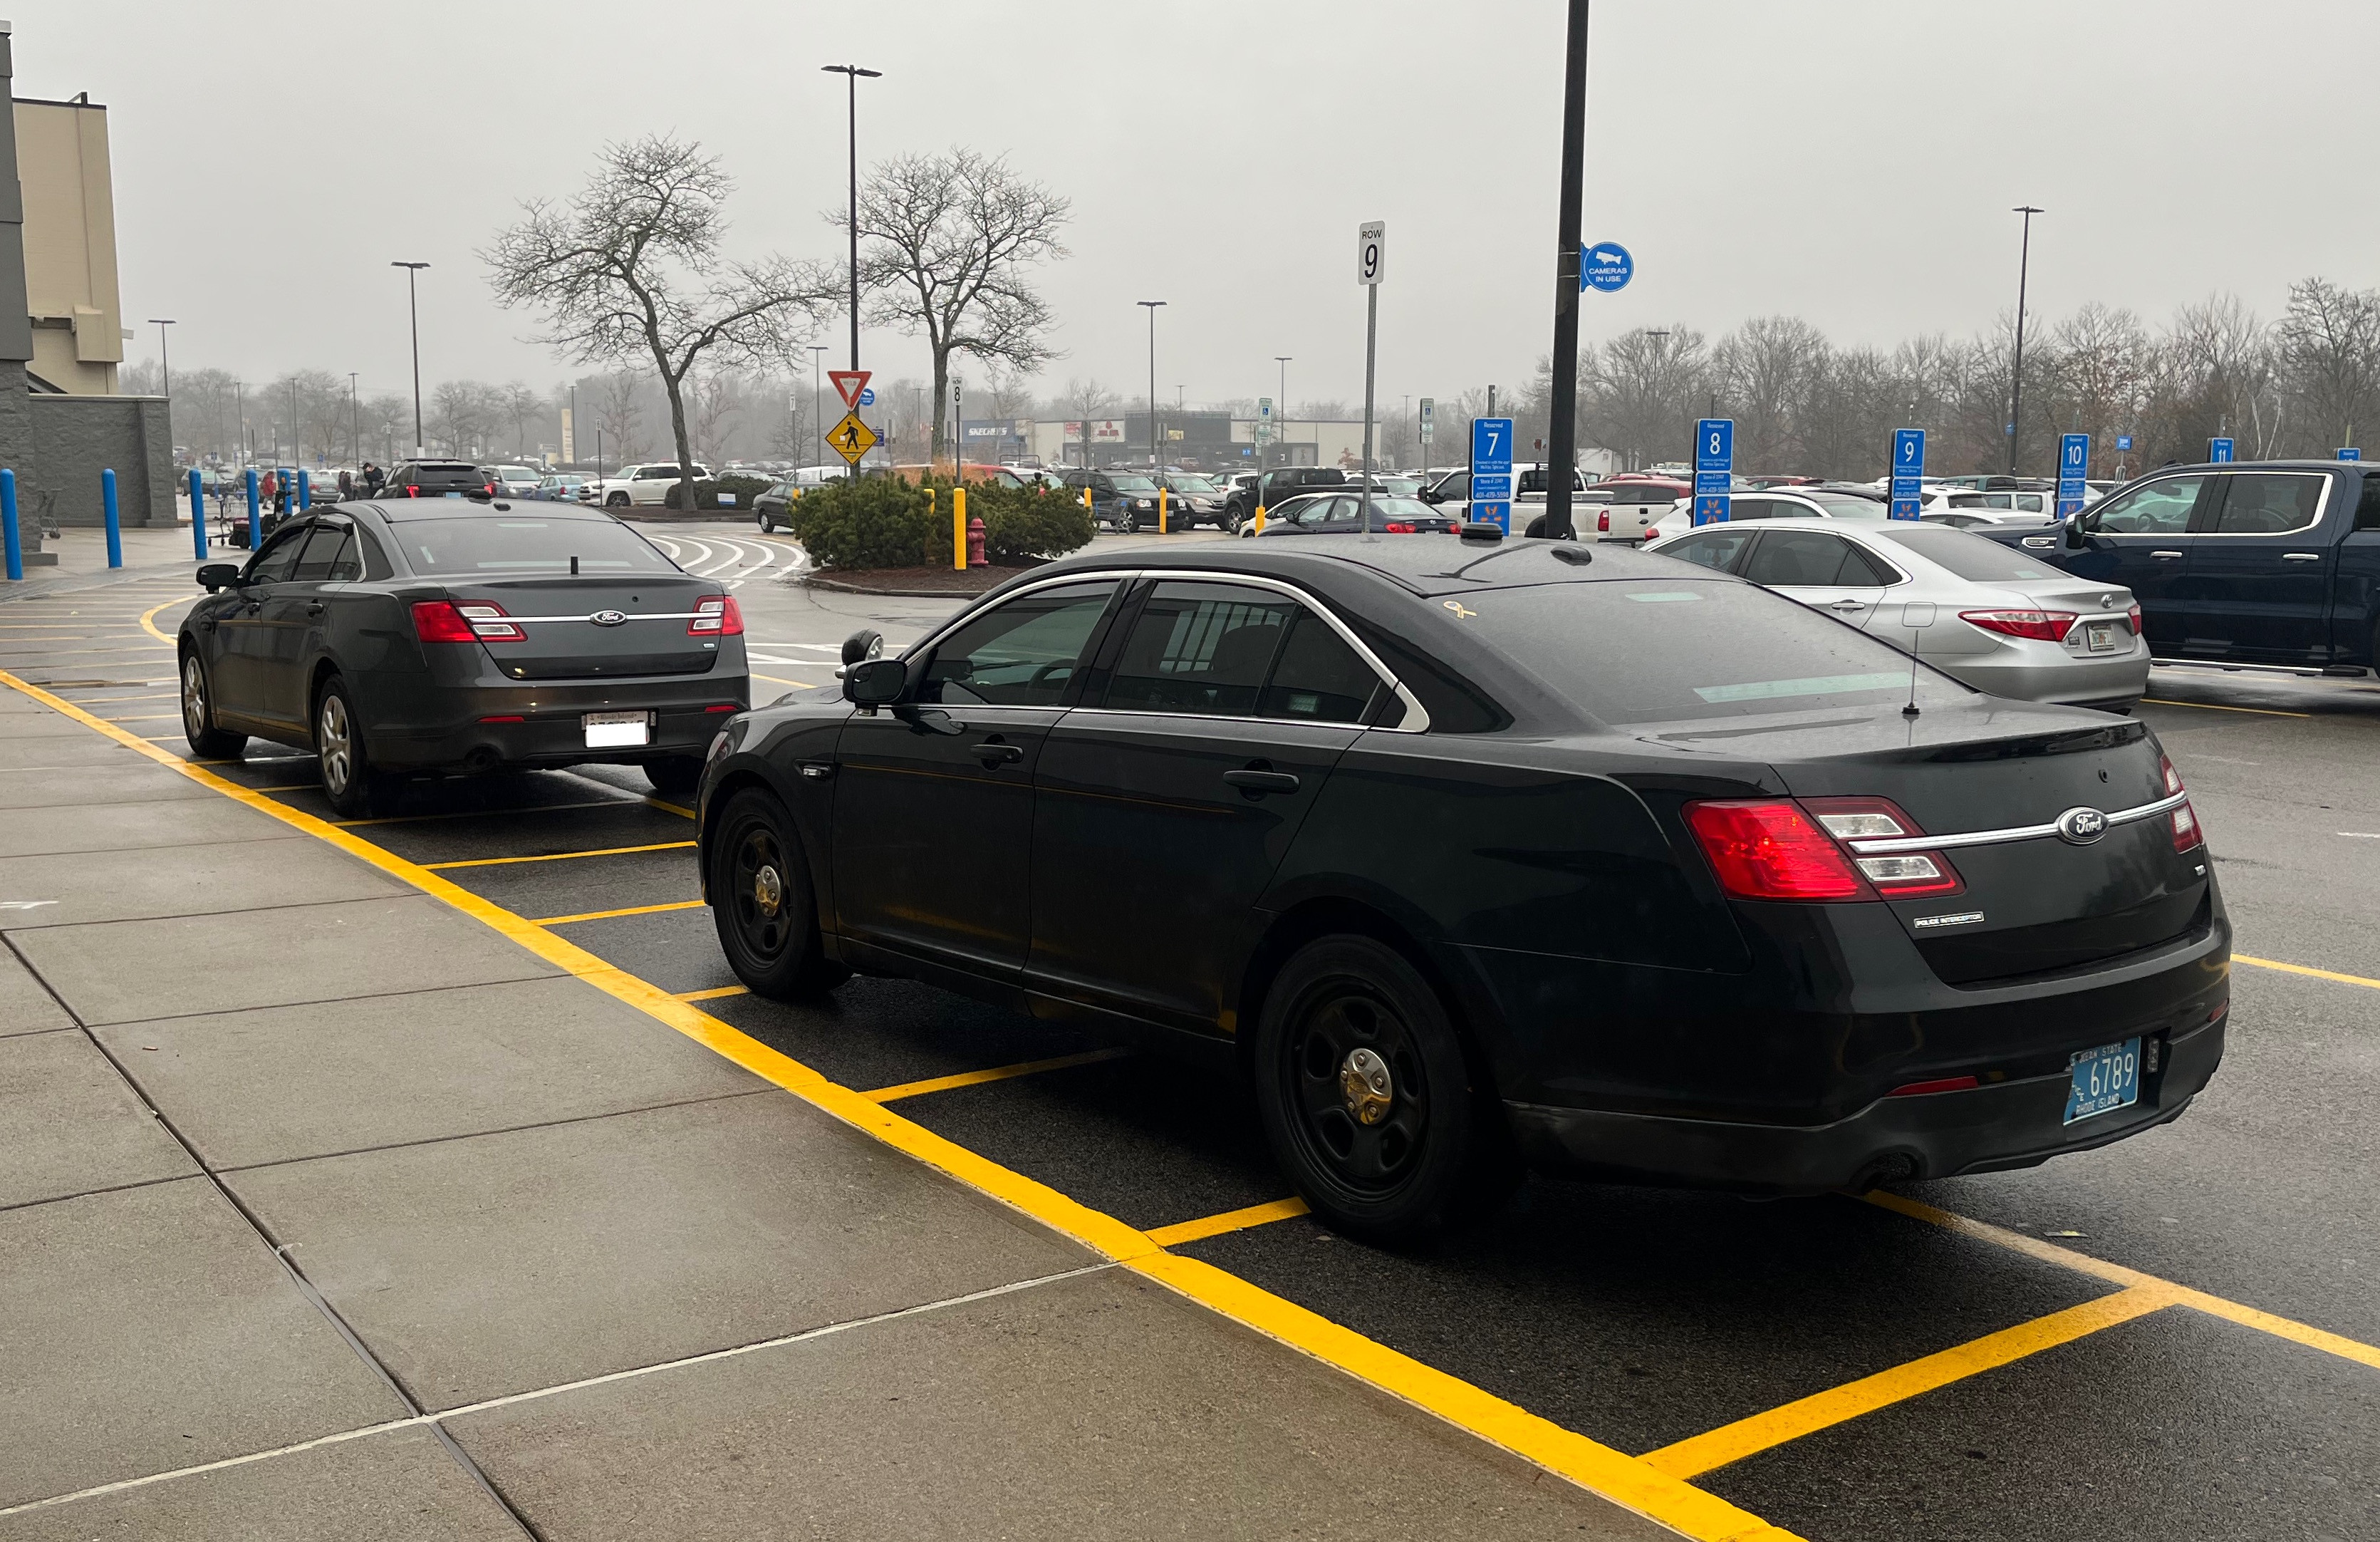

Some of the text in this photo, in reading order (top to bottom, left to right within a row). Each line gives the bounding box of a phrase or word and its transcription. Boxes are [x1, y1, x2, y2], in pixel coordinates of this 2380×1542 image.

[1361, 229, 1382, 239] ROW
[1365, 244, 1378, 279] 9
[955, 386, 960, 402] 8
[1487, 433, 1500, 457] 7
[1710, 432, 1720, 455] 8
[1905, 441, 1914, 462] 9
[2068, 445, 2082, 465] 10
[2076, 813, 2102, 834] Ford
[2091, 1052, 2134, 1097] 6789
[2098, 1092, 2121, 1109] ISLAND
